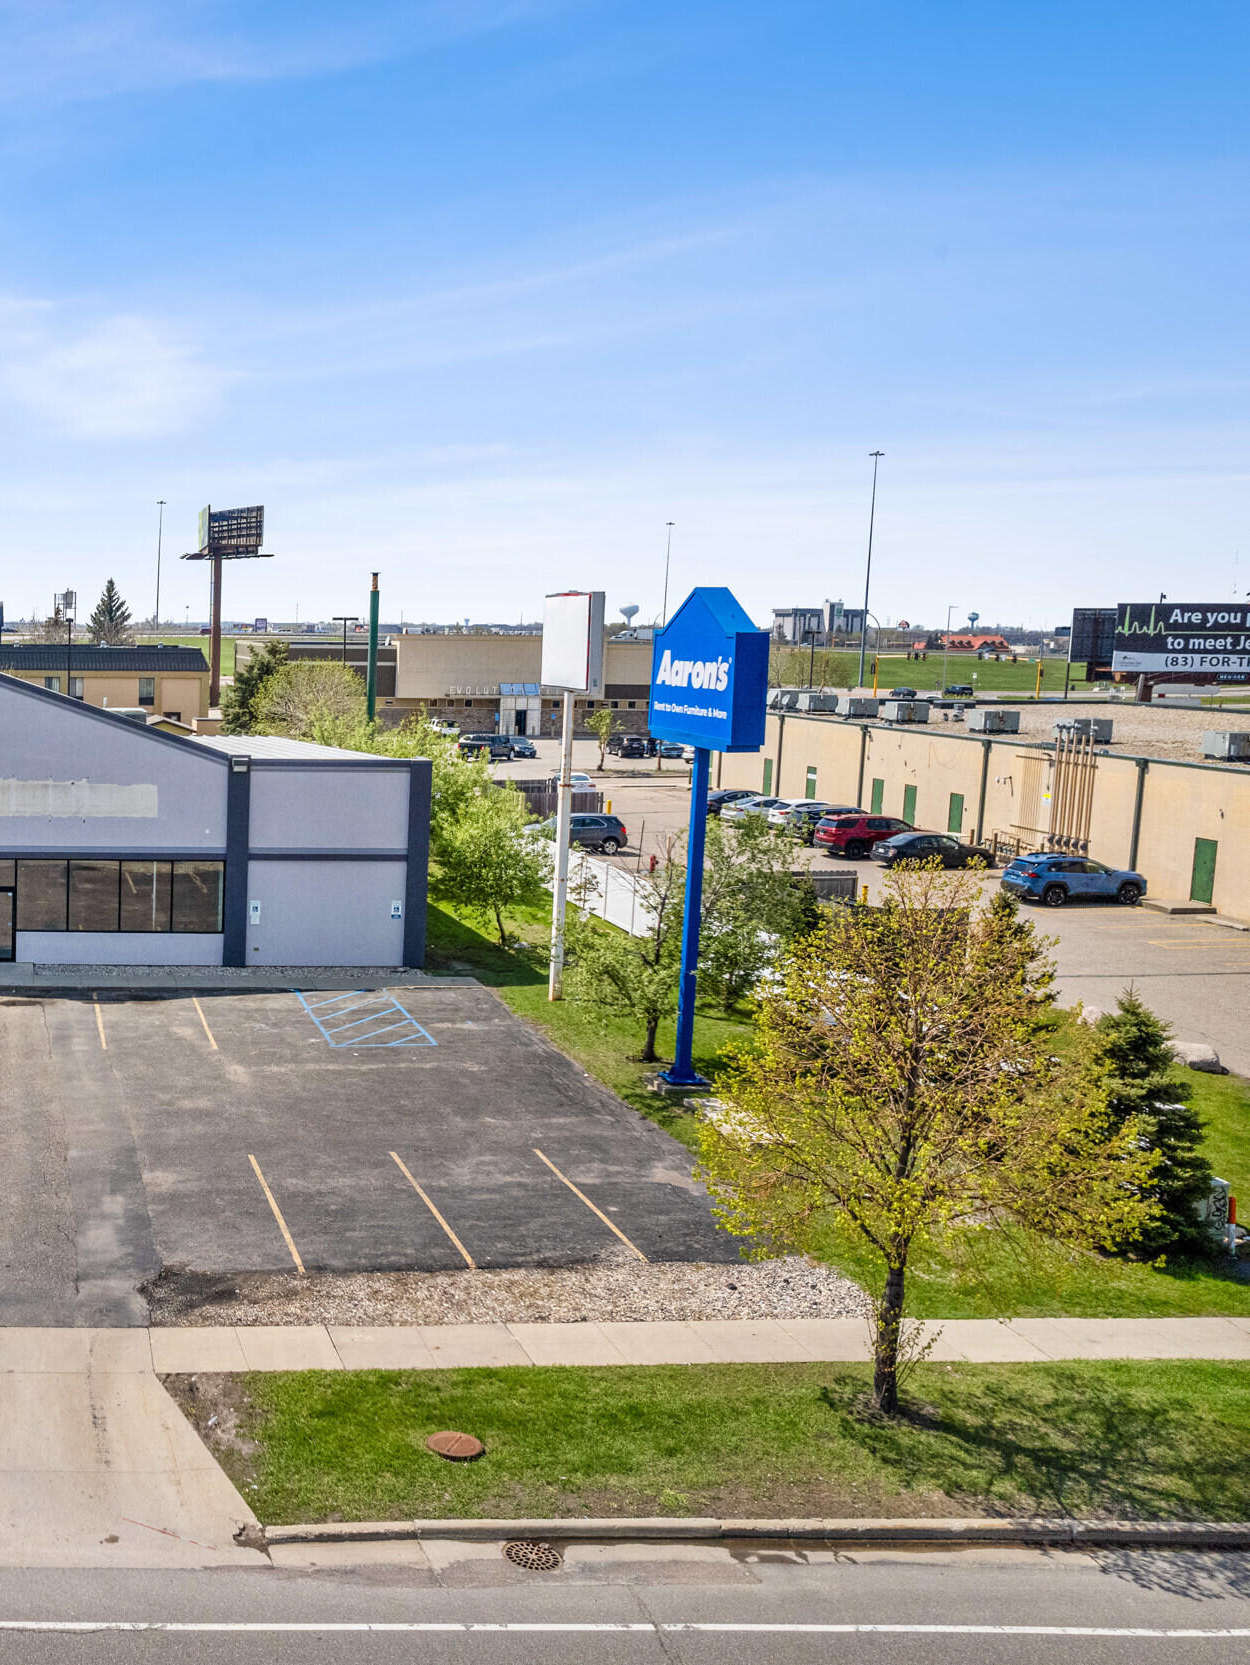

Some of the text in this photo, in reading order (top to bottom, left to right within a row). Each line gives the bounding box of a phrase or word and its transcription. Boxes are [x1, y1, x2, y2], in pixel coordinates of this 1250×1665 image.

[1169, 609, 1202, 624] Are
[1206, 612, 1241, 627] you
[1166, 636, 1185, 649] to
[1188, 637, 1233, 650] meet
[656, 650, 730, 692] Aaron's
[1165, 656, 1194, 668] (83)
[654, 701, 665, 711] Rent
[671, 704, 684, 714] Own
[684, 705, 707, 717] Furniture
[713, 708, 727, 720] More
